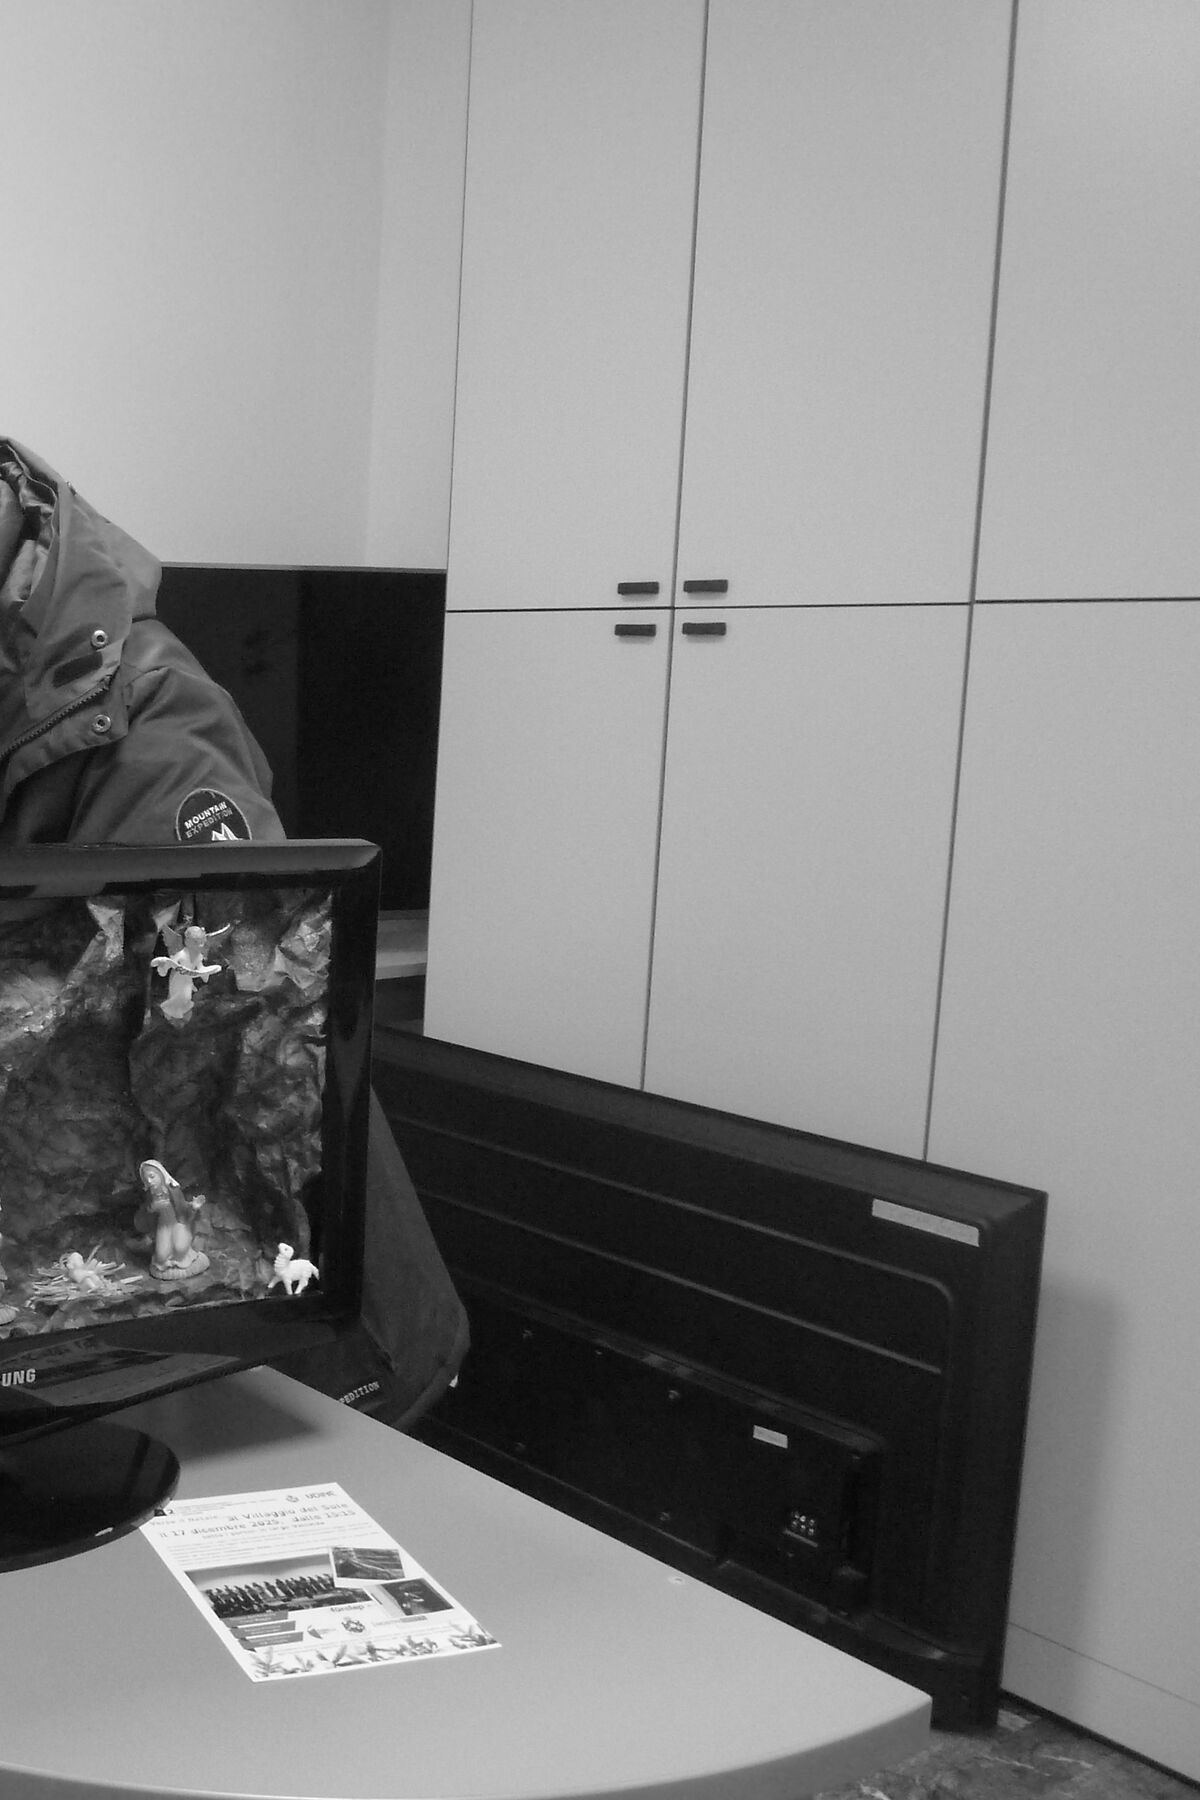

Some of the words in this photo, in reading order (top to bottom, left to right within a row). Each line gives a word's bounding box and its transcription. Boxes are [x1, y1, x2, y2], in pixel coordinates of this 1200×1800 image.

[184, 801, 228, 829] MOUNTAIN
[185, 807, 233, 838] EXPEDITION
[242, 1509, 296, 1520] Villaggio
[191, 1524, 247, 1534] dicembre
